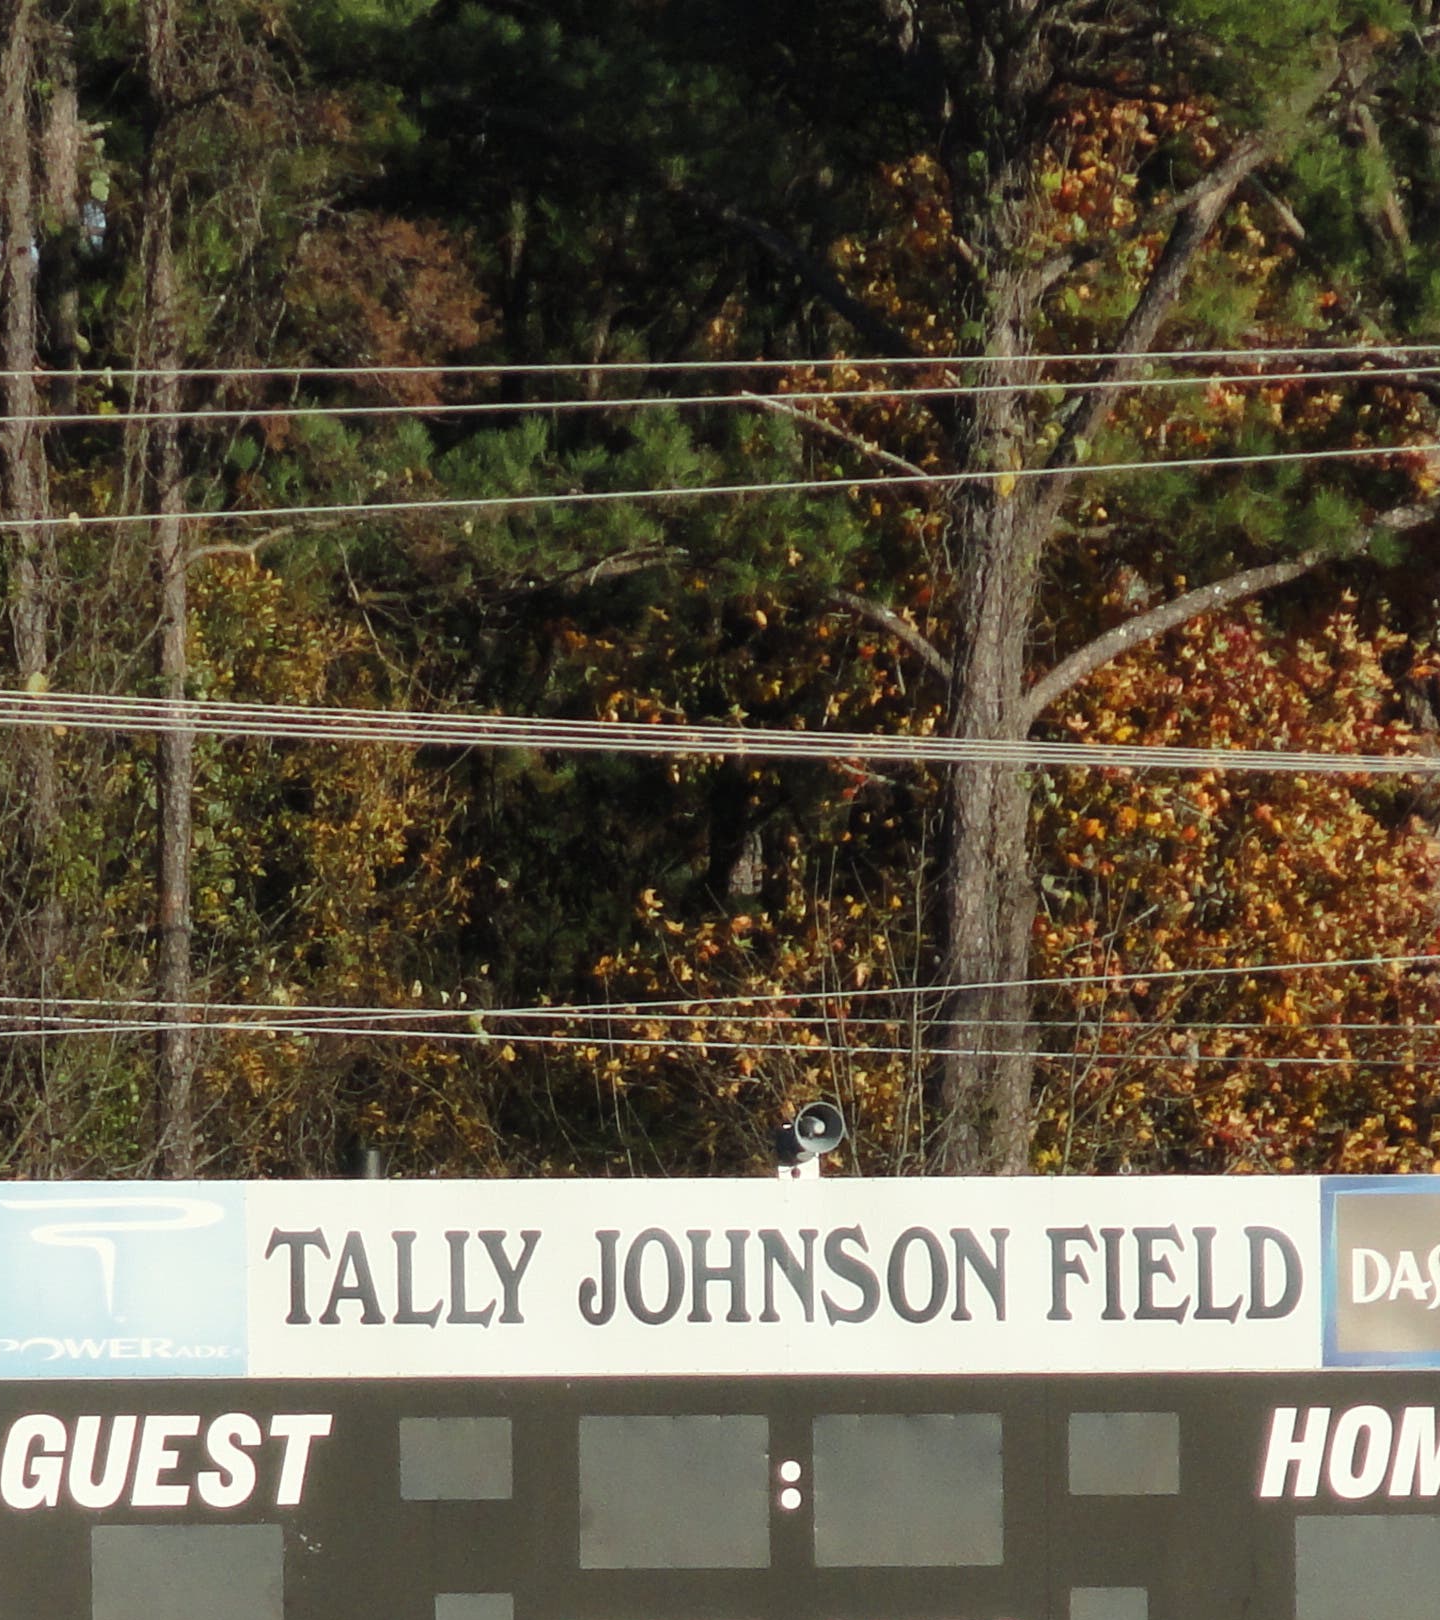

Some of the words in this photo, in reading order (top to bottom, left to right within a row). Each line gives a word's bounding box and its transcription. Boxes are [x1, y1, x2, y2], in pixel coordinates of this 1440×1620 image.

[264, 1227, 542, 1329] TALLY
[577, 1224, 1010, 1327] JOHNSON
[1045, 1224, 1303, 1325] FIELD
[0, 1412, 334, 1510] GUEST
